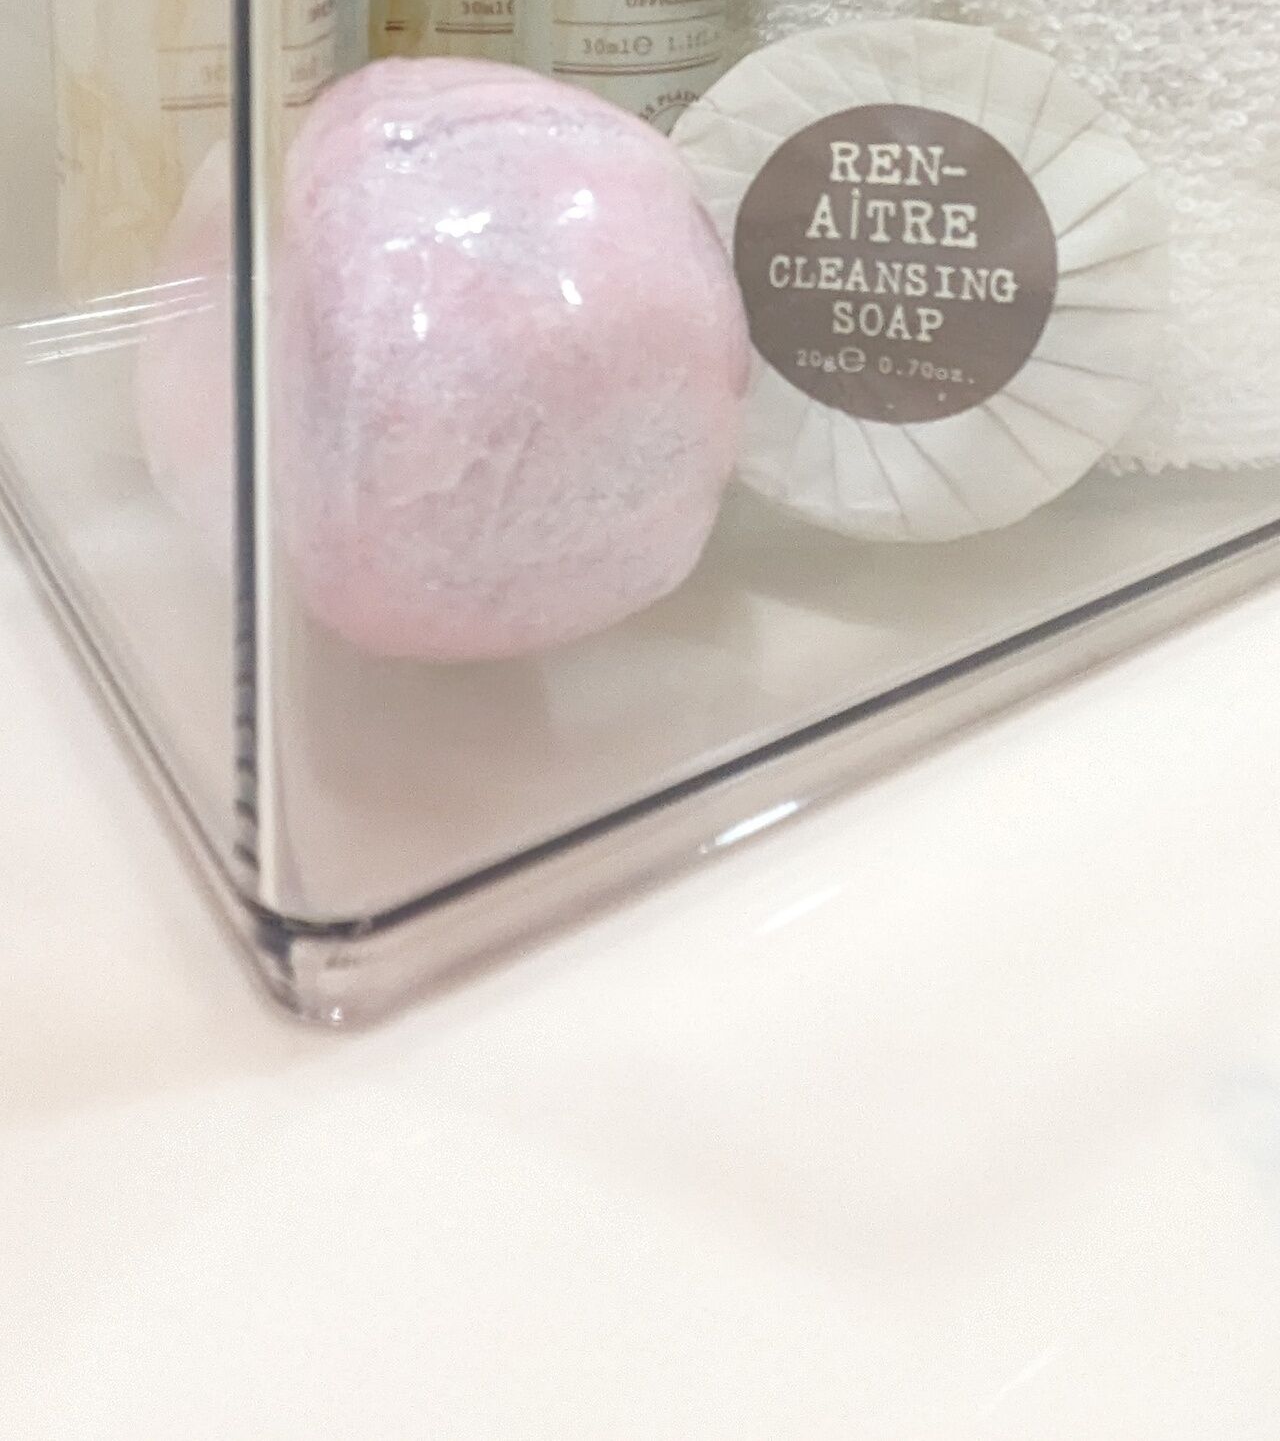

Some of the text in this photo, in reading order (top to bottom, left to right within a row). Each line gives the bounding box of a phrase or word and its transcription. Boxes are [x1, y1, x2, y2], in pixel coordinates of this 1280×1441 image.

[829, 141, 967, 186] REN-
[769, 255, 1019, 303] CLEANSING
[832, 301, 944, 343] SOAP
